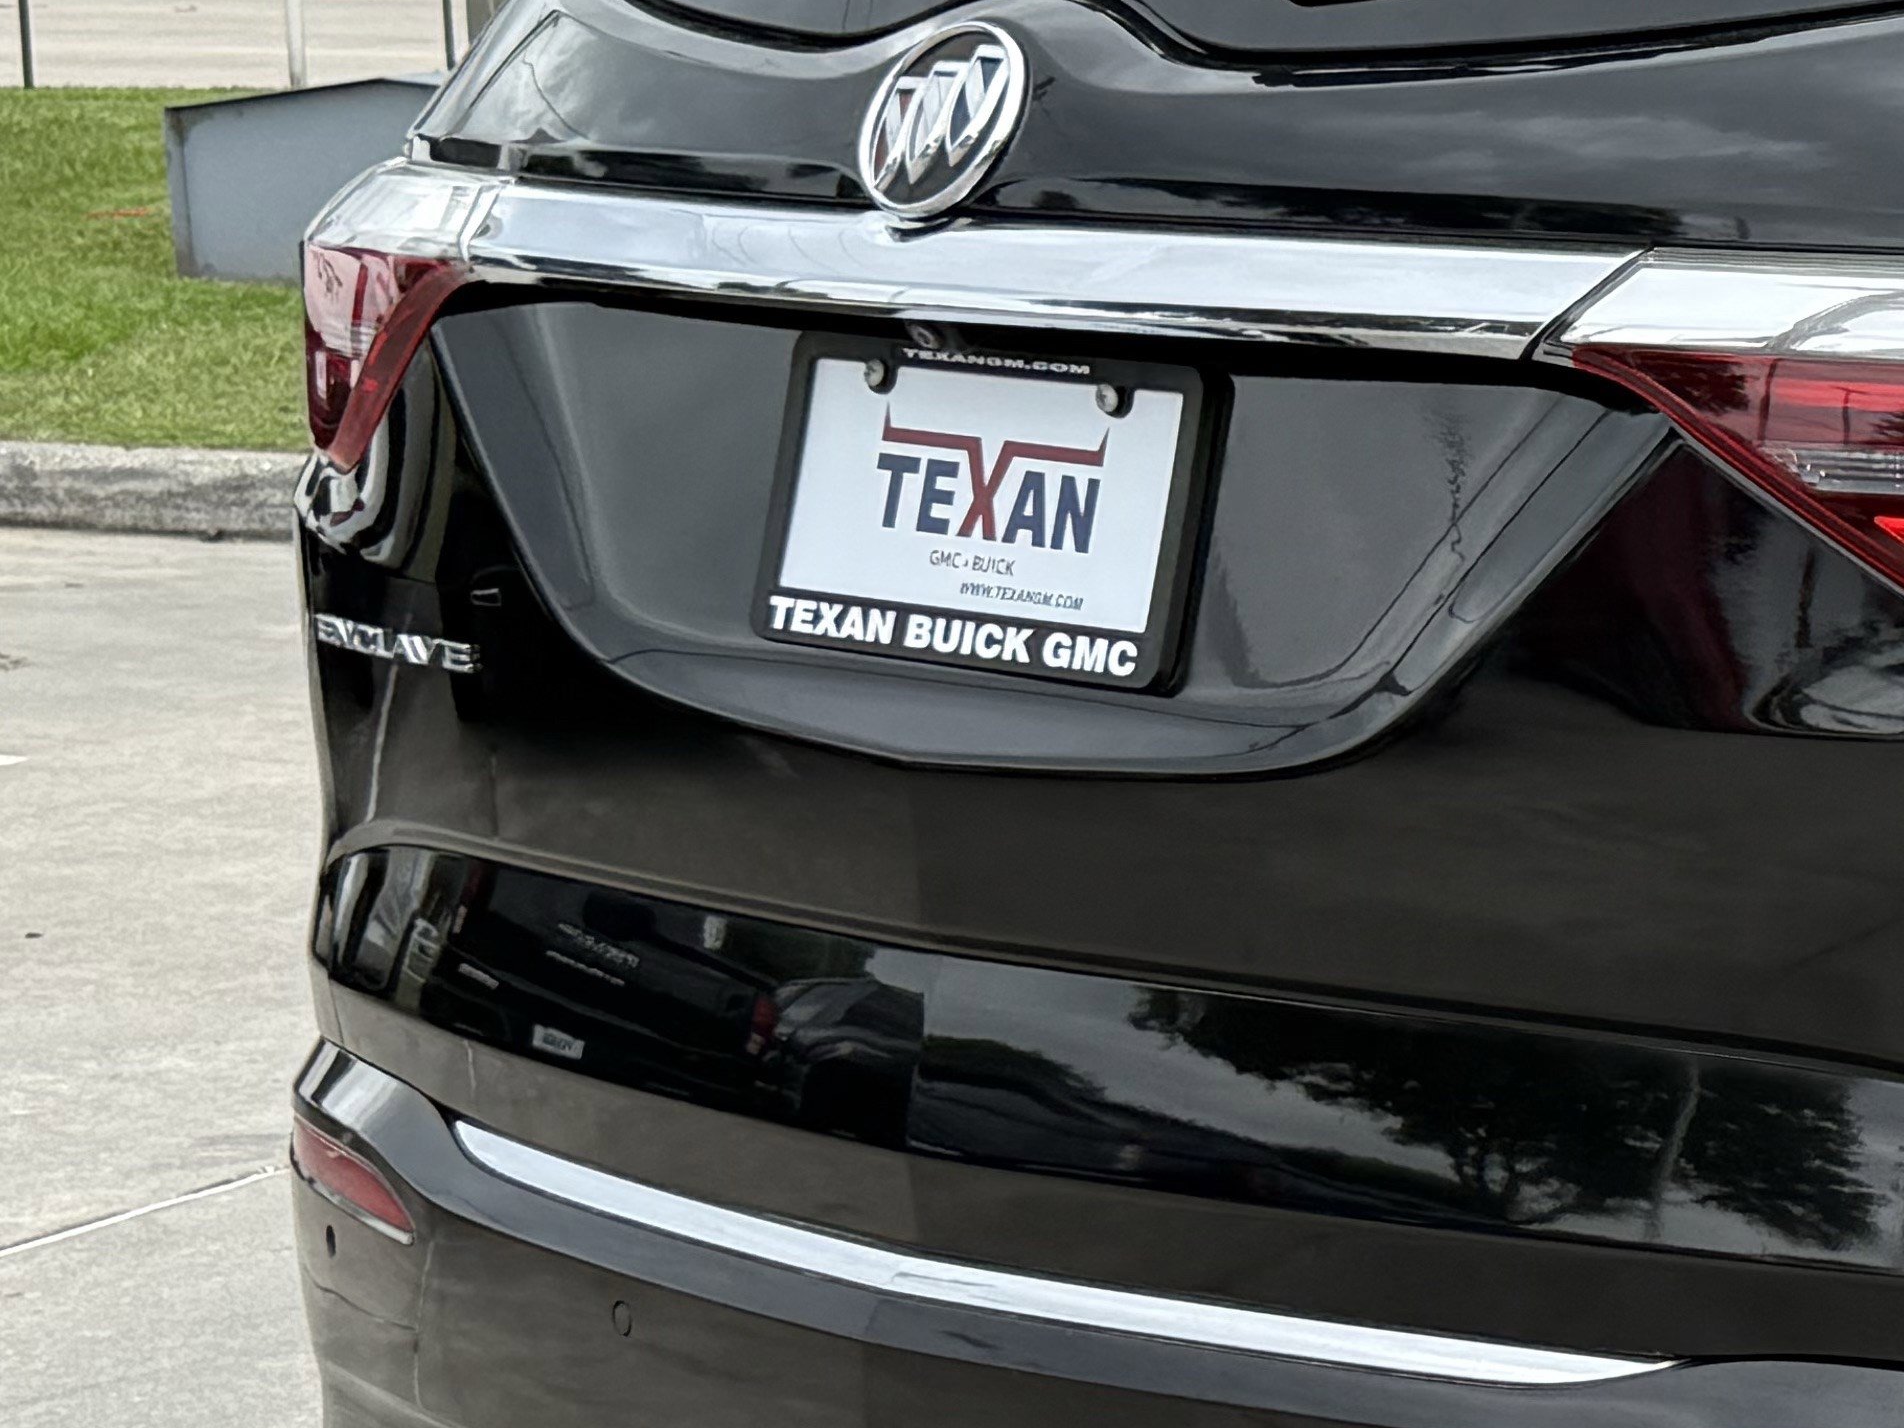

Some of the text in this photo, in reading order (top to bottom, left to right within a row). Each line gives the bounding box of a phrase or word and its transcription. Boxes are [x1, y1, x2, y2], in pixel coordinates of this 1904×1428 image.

[876, 401, 1110, 554] TEXAN
[929, 549, 1016, 576] GMC BUICK
[314, 612, 478, 673] ENCLAVE
[768, 595, 1139, 677] TEXAN BUICK GMC
